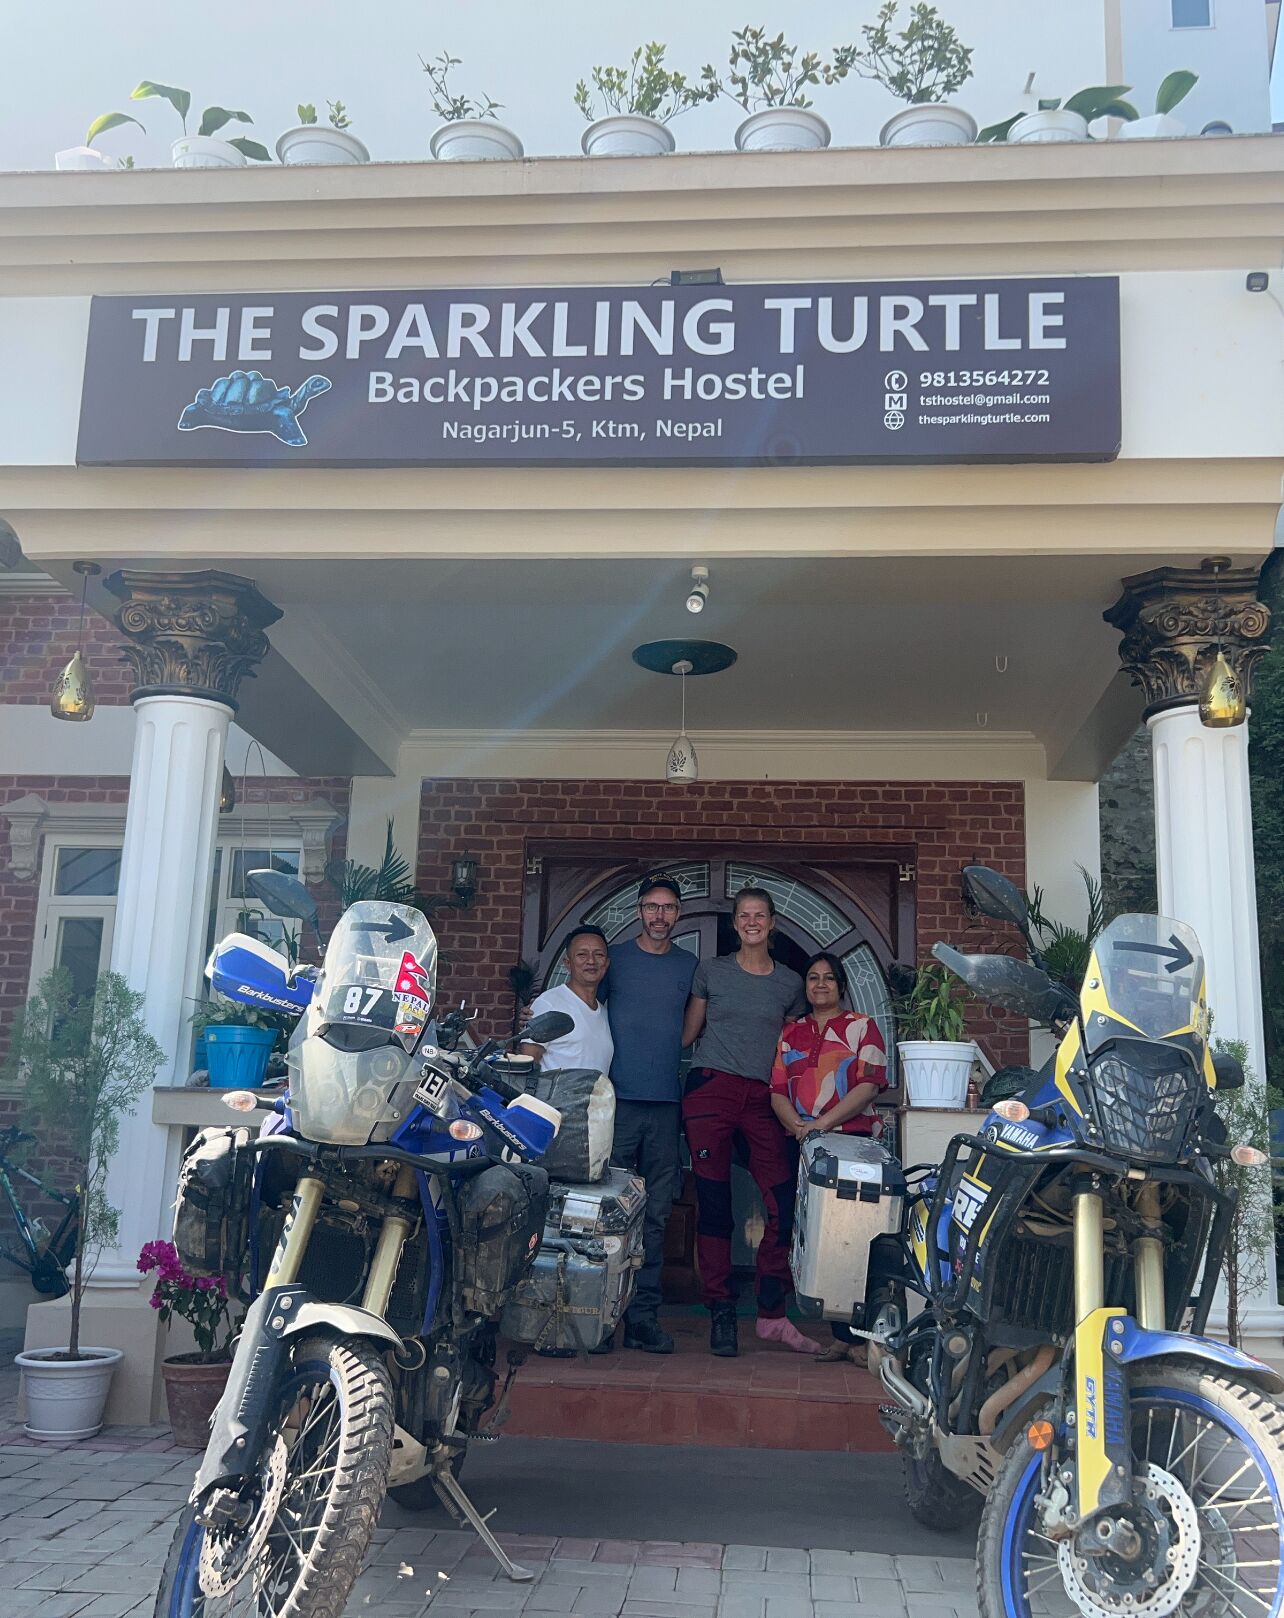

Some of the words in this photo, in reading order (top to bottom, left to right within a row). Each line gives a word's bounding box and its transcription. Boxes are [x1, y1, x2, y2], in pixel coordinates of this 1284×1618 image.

[131, 306, 275, 362] THE
[298, 298, 736, 361] SPARKLING
[764, 292, 1067, 354] TURTLE
[367, 367, 645, 411] Backpackers
[663, 364, 804, 401] Hostel
[919, 369, 1050, 387] 9813564272
[919, 393, 1050, 407] tsthostel@gmail.com
[442, 420, 582, 443] Nagarjun-5,
[591, 419, 646, 442] Ktm,
[656, 418, 723, 442] Nepal
[918, 412, 1050, 426] thesparklingturtle.com
[237, 984, 306, 1013] Barkbusters
[343, 986, 384, 1016] 87
[392, 992, 430, 1014] NEPAL
[479, 1109, 527, 1151] Barkbusters
[1000, 1123, 1040, 1149] YAMAHA
[1086, 1376, 1097, 1440] GYTR
